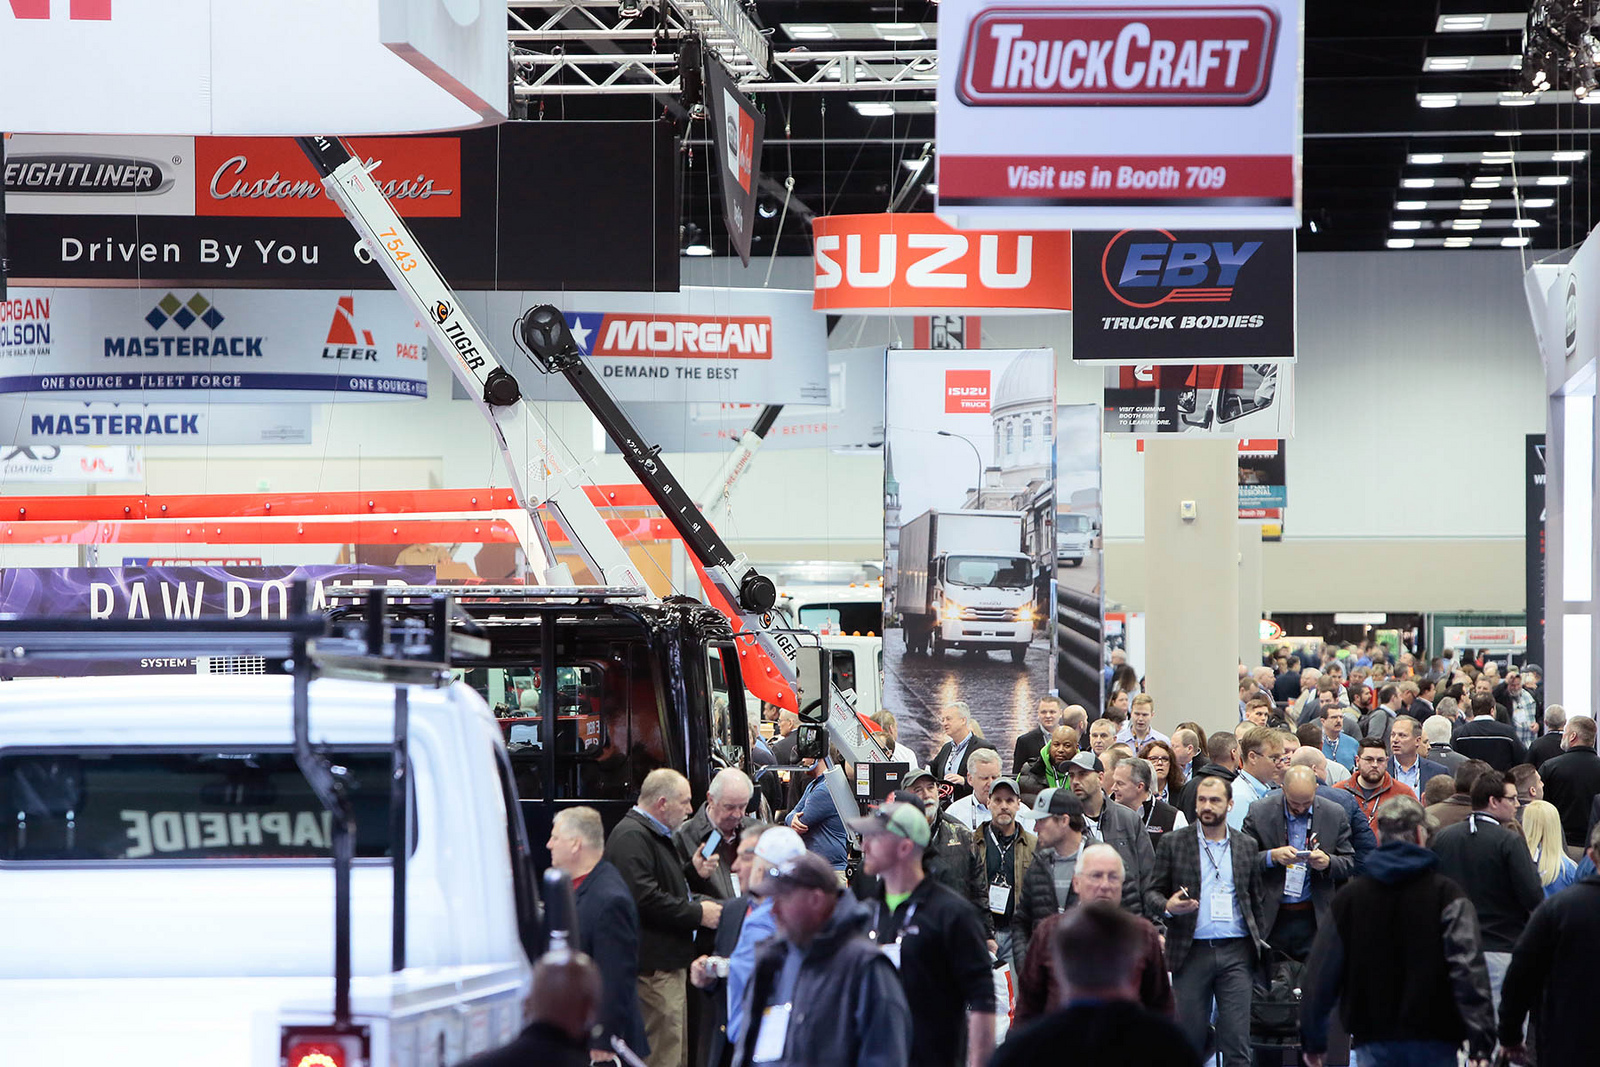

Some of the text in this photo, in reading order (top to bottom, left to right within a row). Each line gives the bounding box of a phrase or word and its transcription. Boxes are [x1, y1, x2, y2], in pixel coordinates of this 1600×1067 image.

[209, 155, 321, 200] Custom
[1007, 165, 1226, 189] Visit us in Booth 709
[61, 237, 319, 268] Driven By You
[380, 227, 417, 272] 7543
[1118, 241, 1264, 288] EBY
[1102, 314, 1265, 330] TRUCK BODIES
[104, 337, 263, 357] MASTERACK
[446, 321, 485, 371] TIGER
[602, 320, 767, 354] MORGAN
[322, 347, 378, 362] LEER
[397, 343, 418, 360] PACE
[41, 375, 241, 389] ONE SOURCE FLEET FORCE
[603, 365, 739, 380] DEMAND THE BEST
[350, 378, 374, 390] ONE
[377, 380, 411, 393] SOURCE
[948, 387, 987, 396] ISUZU
[31, 414, 199, 435] MASTERACK
[783, 422, 828, 435] BETTER
[90, 582, 204, 620] RAW
[141, 659, 187, 668] SYSTEM
